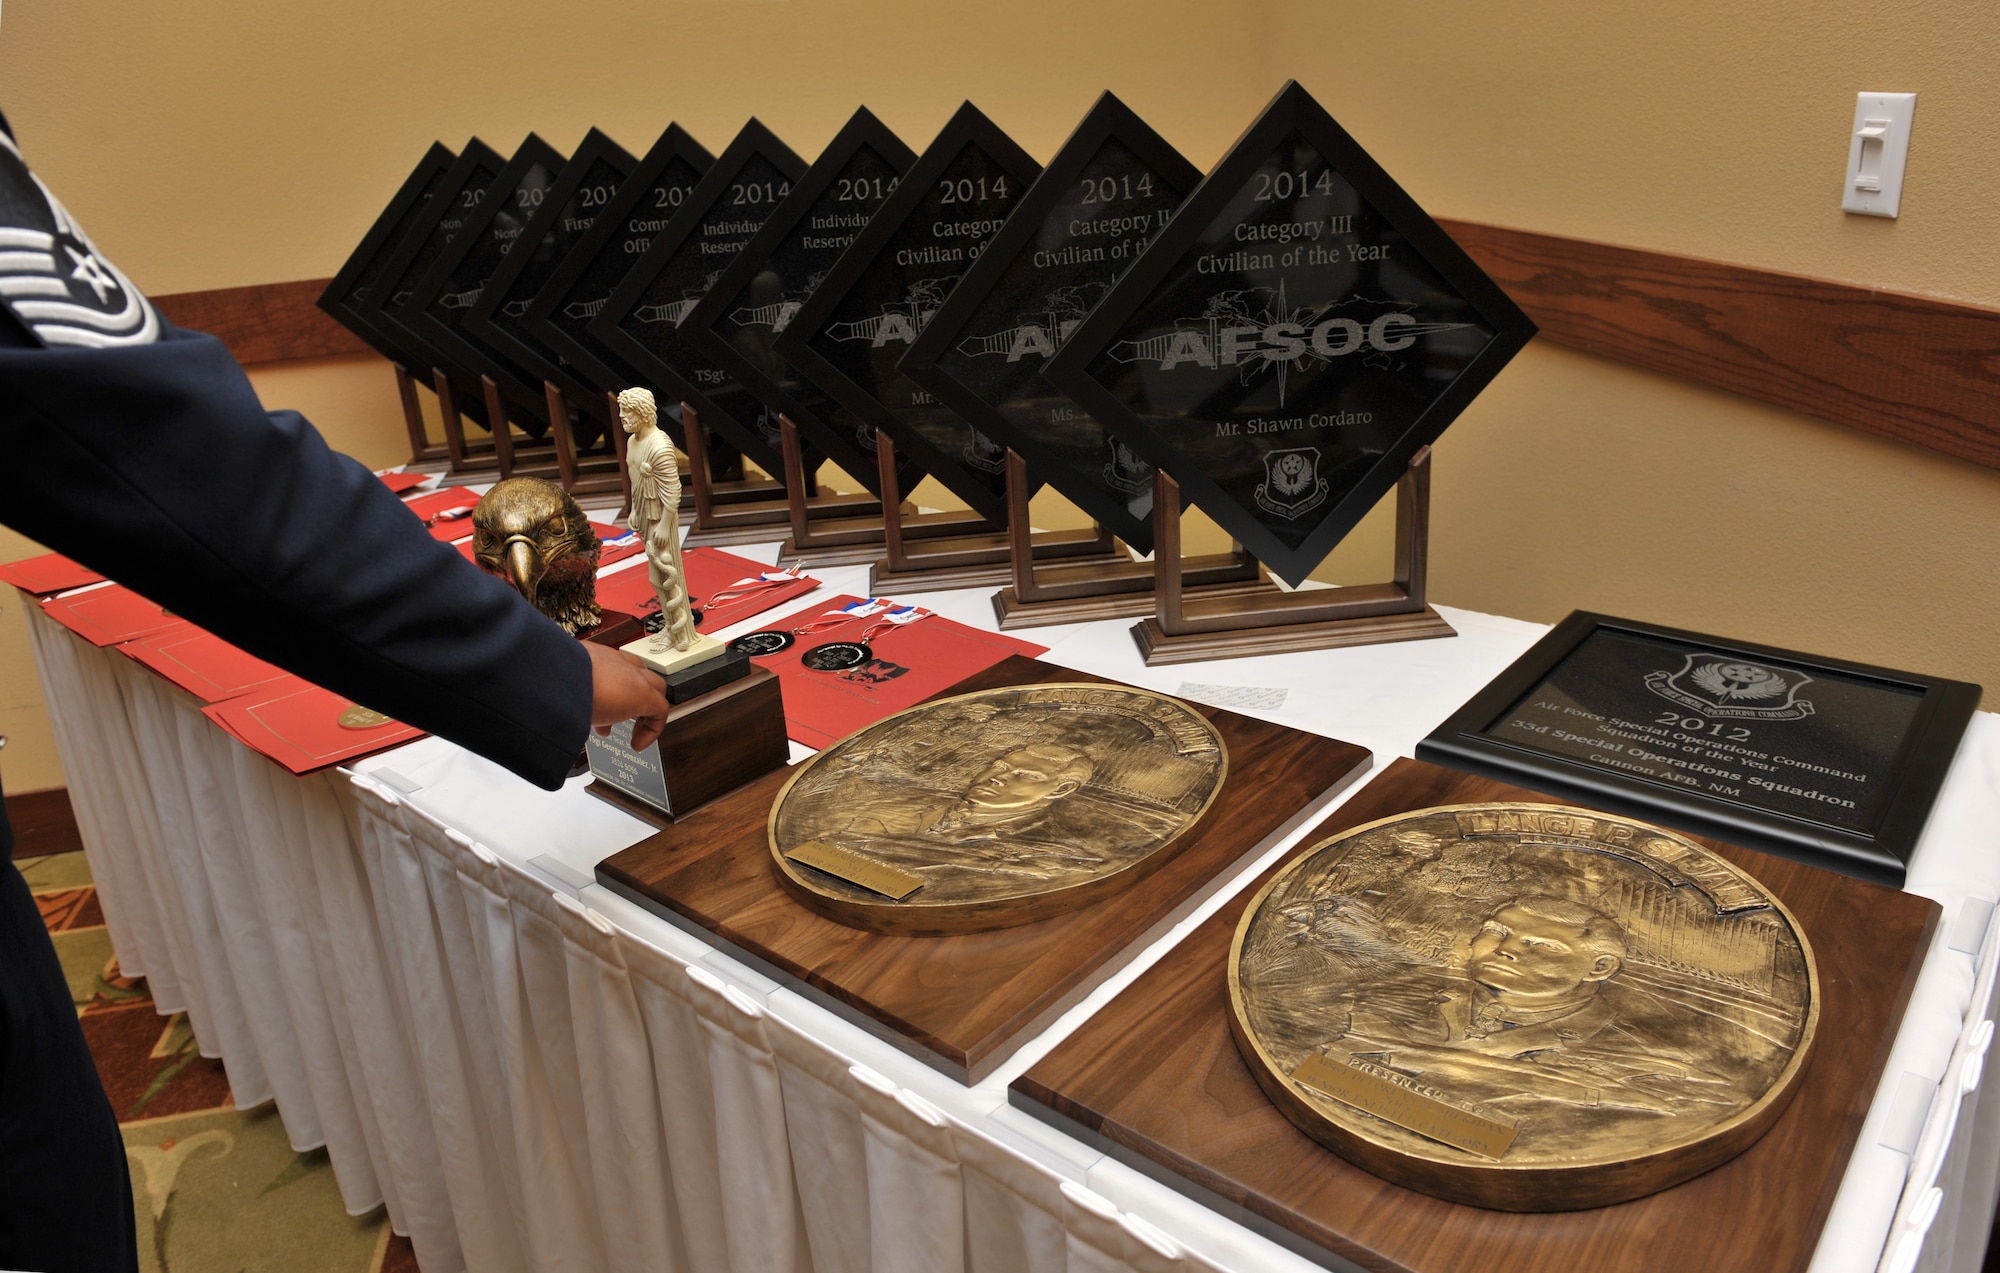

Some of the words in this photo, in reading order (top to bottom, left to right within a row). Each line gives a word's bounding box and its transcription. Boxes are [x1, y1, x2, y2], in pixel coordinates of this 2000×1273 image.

[579, 185, 616, 207] 201
[654, 186, 694, 208] 201
[731, 181, 789, 206] 2014
[838, 176, 900, 201] 2014
[939, 176, 1009, 204] 2014
[1080, 173, 1154, 205] 2014
[1254, 169, 1334, 202] 2014
[932, 219, 1004, 240] Categor
[1069, 214, 1152, 239] Category
[1234, 218, 1324, 243] Category
[1331, 215, 1353, 234] III
[896, 248, 964, 267] Civilian
[1034, 248, 1104, 269] Civilian
[1111, 239, 1131, 259] of
[1197, 253, 1276, 275] Civilian
[1282, 249, 1303, 268] of
[1309, 245, 1340, 266] the
[1347, 242, 1391, 263] Year
[1160, 313, 1417, 371] AFSOC
[695, 369, 726, 385] TSgt
[1215, 420, 1242, 437] Mr.
[1247, 416, 1303, 436] Shawn
[1309, 410, 1373, 430] Cordaro
[1028, 689, 1124, 706] LANCE
[1655, 711, 1751, 742] 2012
[1703, 706, 1756, 717] OPERATIONS
[1758, 709, 1800, 719] COMMAND
[601, 740, 621, 756] George
[1534, 701, 1560, 711] Air
[1563, 707, 1605, 722] Force
[1609, 717, 1670, 737] Special
[1672, 732, 1769, 760] Operations
[1772, 755, 1867, 783] Command
[1596, 725, 1677, 749] Squadron
[1682, 745, 1704, 755] of
[1705, 749, 1734, 762] the
[1740, 757, 1779, 773] Year
[1511, 720, 1549, 734] 33d
[1552, 729, 1625, 752] Special
[1627, 747, 1743, 781] Operations
[1747, 776, 1856, 810] Squadron
[1589, 753, 1656, 776] Cannon
[1708, 782, 1741, 797] NM
[1473, 812, 1595, 838] LANCE
[1639, 836, 1761, 907] SIJAN
[1348, 1058, 1443, 1100] PRESENTED
